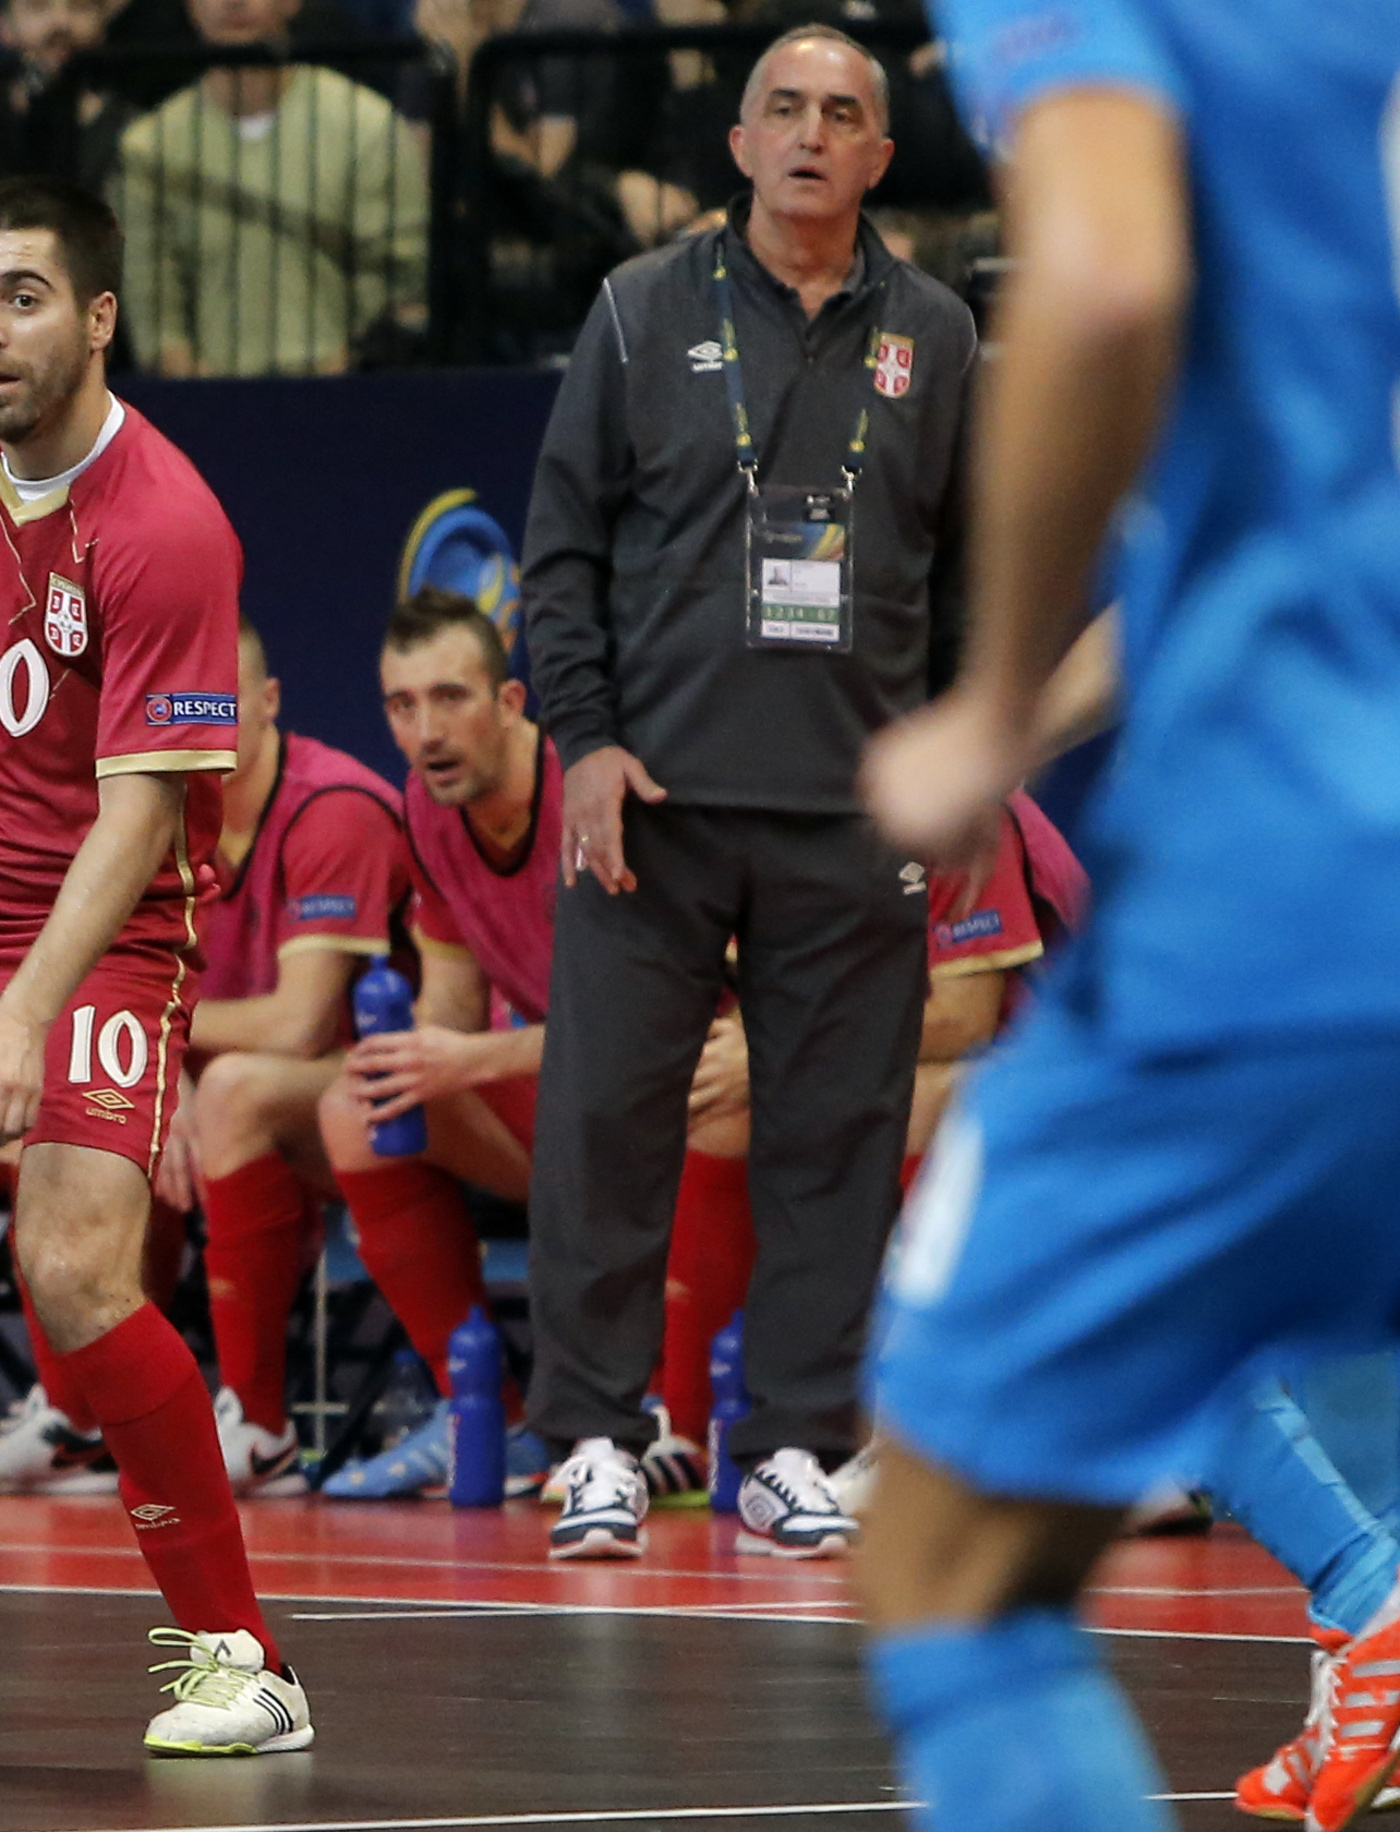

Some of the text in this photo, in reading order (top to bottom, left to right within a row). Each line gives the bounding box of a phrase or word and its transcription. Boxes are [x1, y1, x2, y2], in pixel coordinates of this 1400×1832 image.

[173, 700, 237, 717] RESPECT
[68, 1004, 148, 1088] 10
[85, 1106, 127, 1125] umbro
